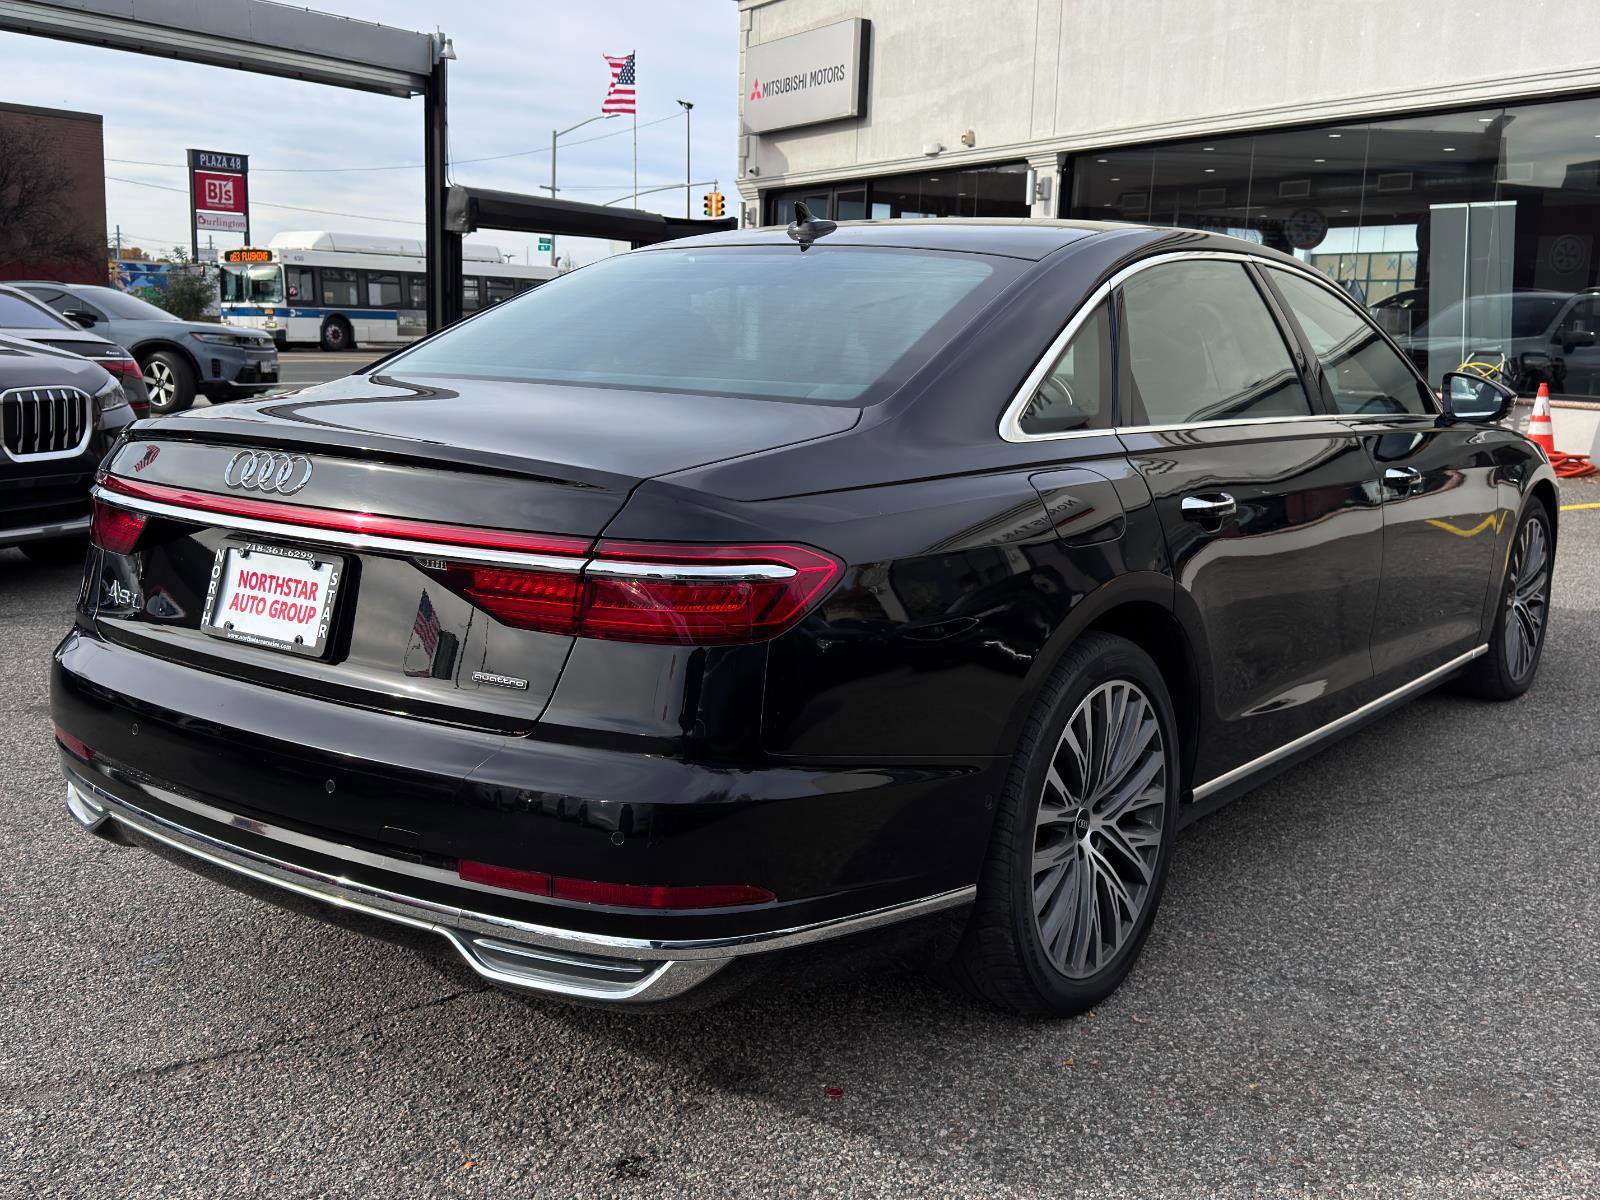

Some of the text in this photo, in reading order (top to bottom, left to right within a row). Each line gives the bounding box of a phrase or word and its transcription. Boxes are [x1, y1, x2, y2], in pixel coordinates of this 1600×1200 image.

[762, 64, 845, 98] MITSUBISHI MOTORS
[200, 153, 241, 169] PLAZA 48
[197, 215, 246, 228] Burlington
[201, 548, 225, 626] NORTH
[237, 569, 319, 602] NORTHSTAR
[229, 592, 317, 625] AUTO GROUP
[317, 572, 339, 639] STAR
[473, 672, 526, 688] quattro
